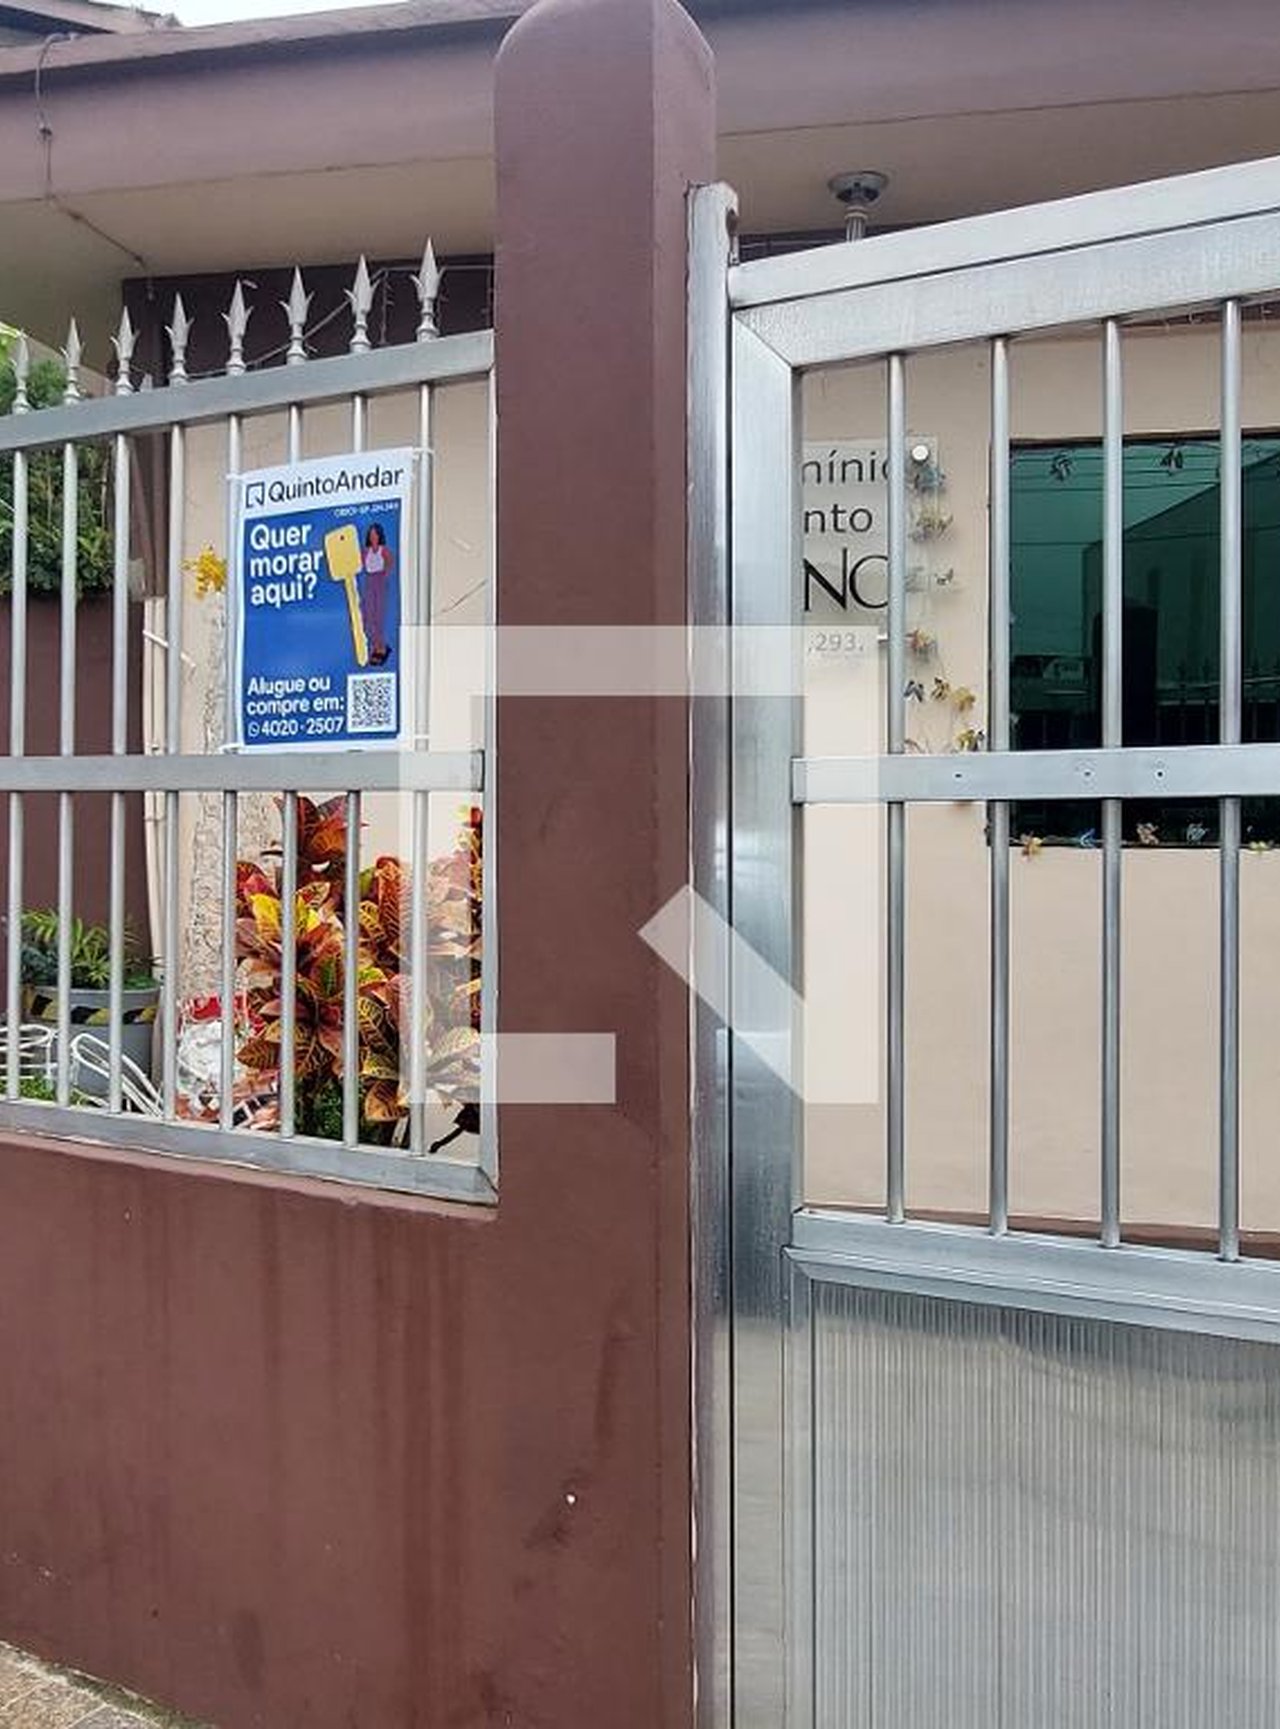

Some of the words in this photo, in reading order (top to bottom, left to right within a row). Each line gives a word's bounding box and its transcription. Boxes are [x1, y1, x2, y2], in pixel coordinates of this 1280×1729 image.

[268, 465, 404, 503] QuintoAndar
[250, 523, 312, 551] Quer
[250, 551, 323, 578] morar
[251, 574, 316, 608] aqui?
[247, 677, 305, 698] Alugue
[308, 677, 330, 691] ou
[247, 698, 310, 717] compre
[313, 697, 344, 712] em:
